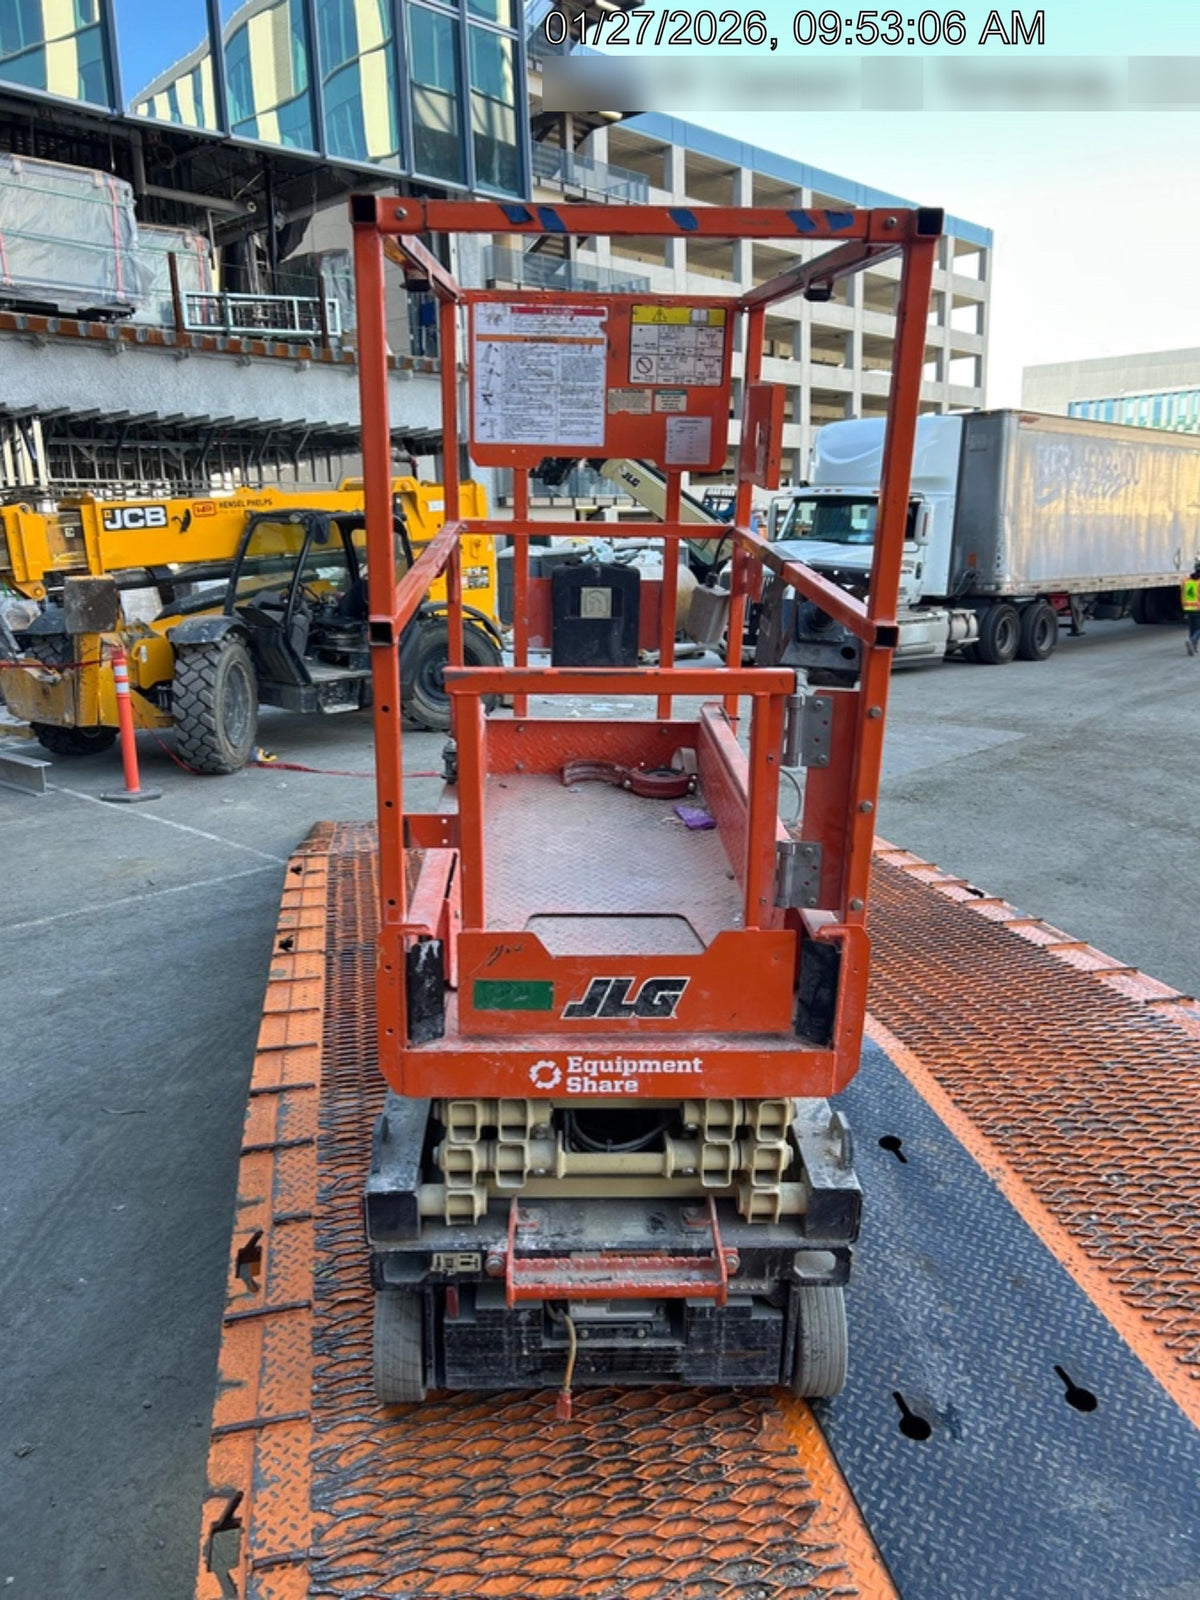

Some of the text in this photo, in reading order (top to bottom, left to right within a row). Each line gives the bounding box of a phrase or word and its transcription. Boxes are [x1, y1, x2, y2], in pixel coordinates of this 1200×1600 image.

[621, 472, 641, 487] JLG
[218, 498, 273, 509] HENSEL PHELPS
[104, 506, 167, 530] JCB
[560, 976, 692, 1020] JLG
[566, 1056, 703, 1076] Equipment
[566, 1076, 639, 1093] Share
